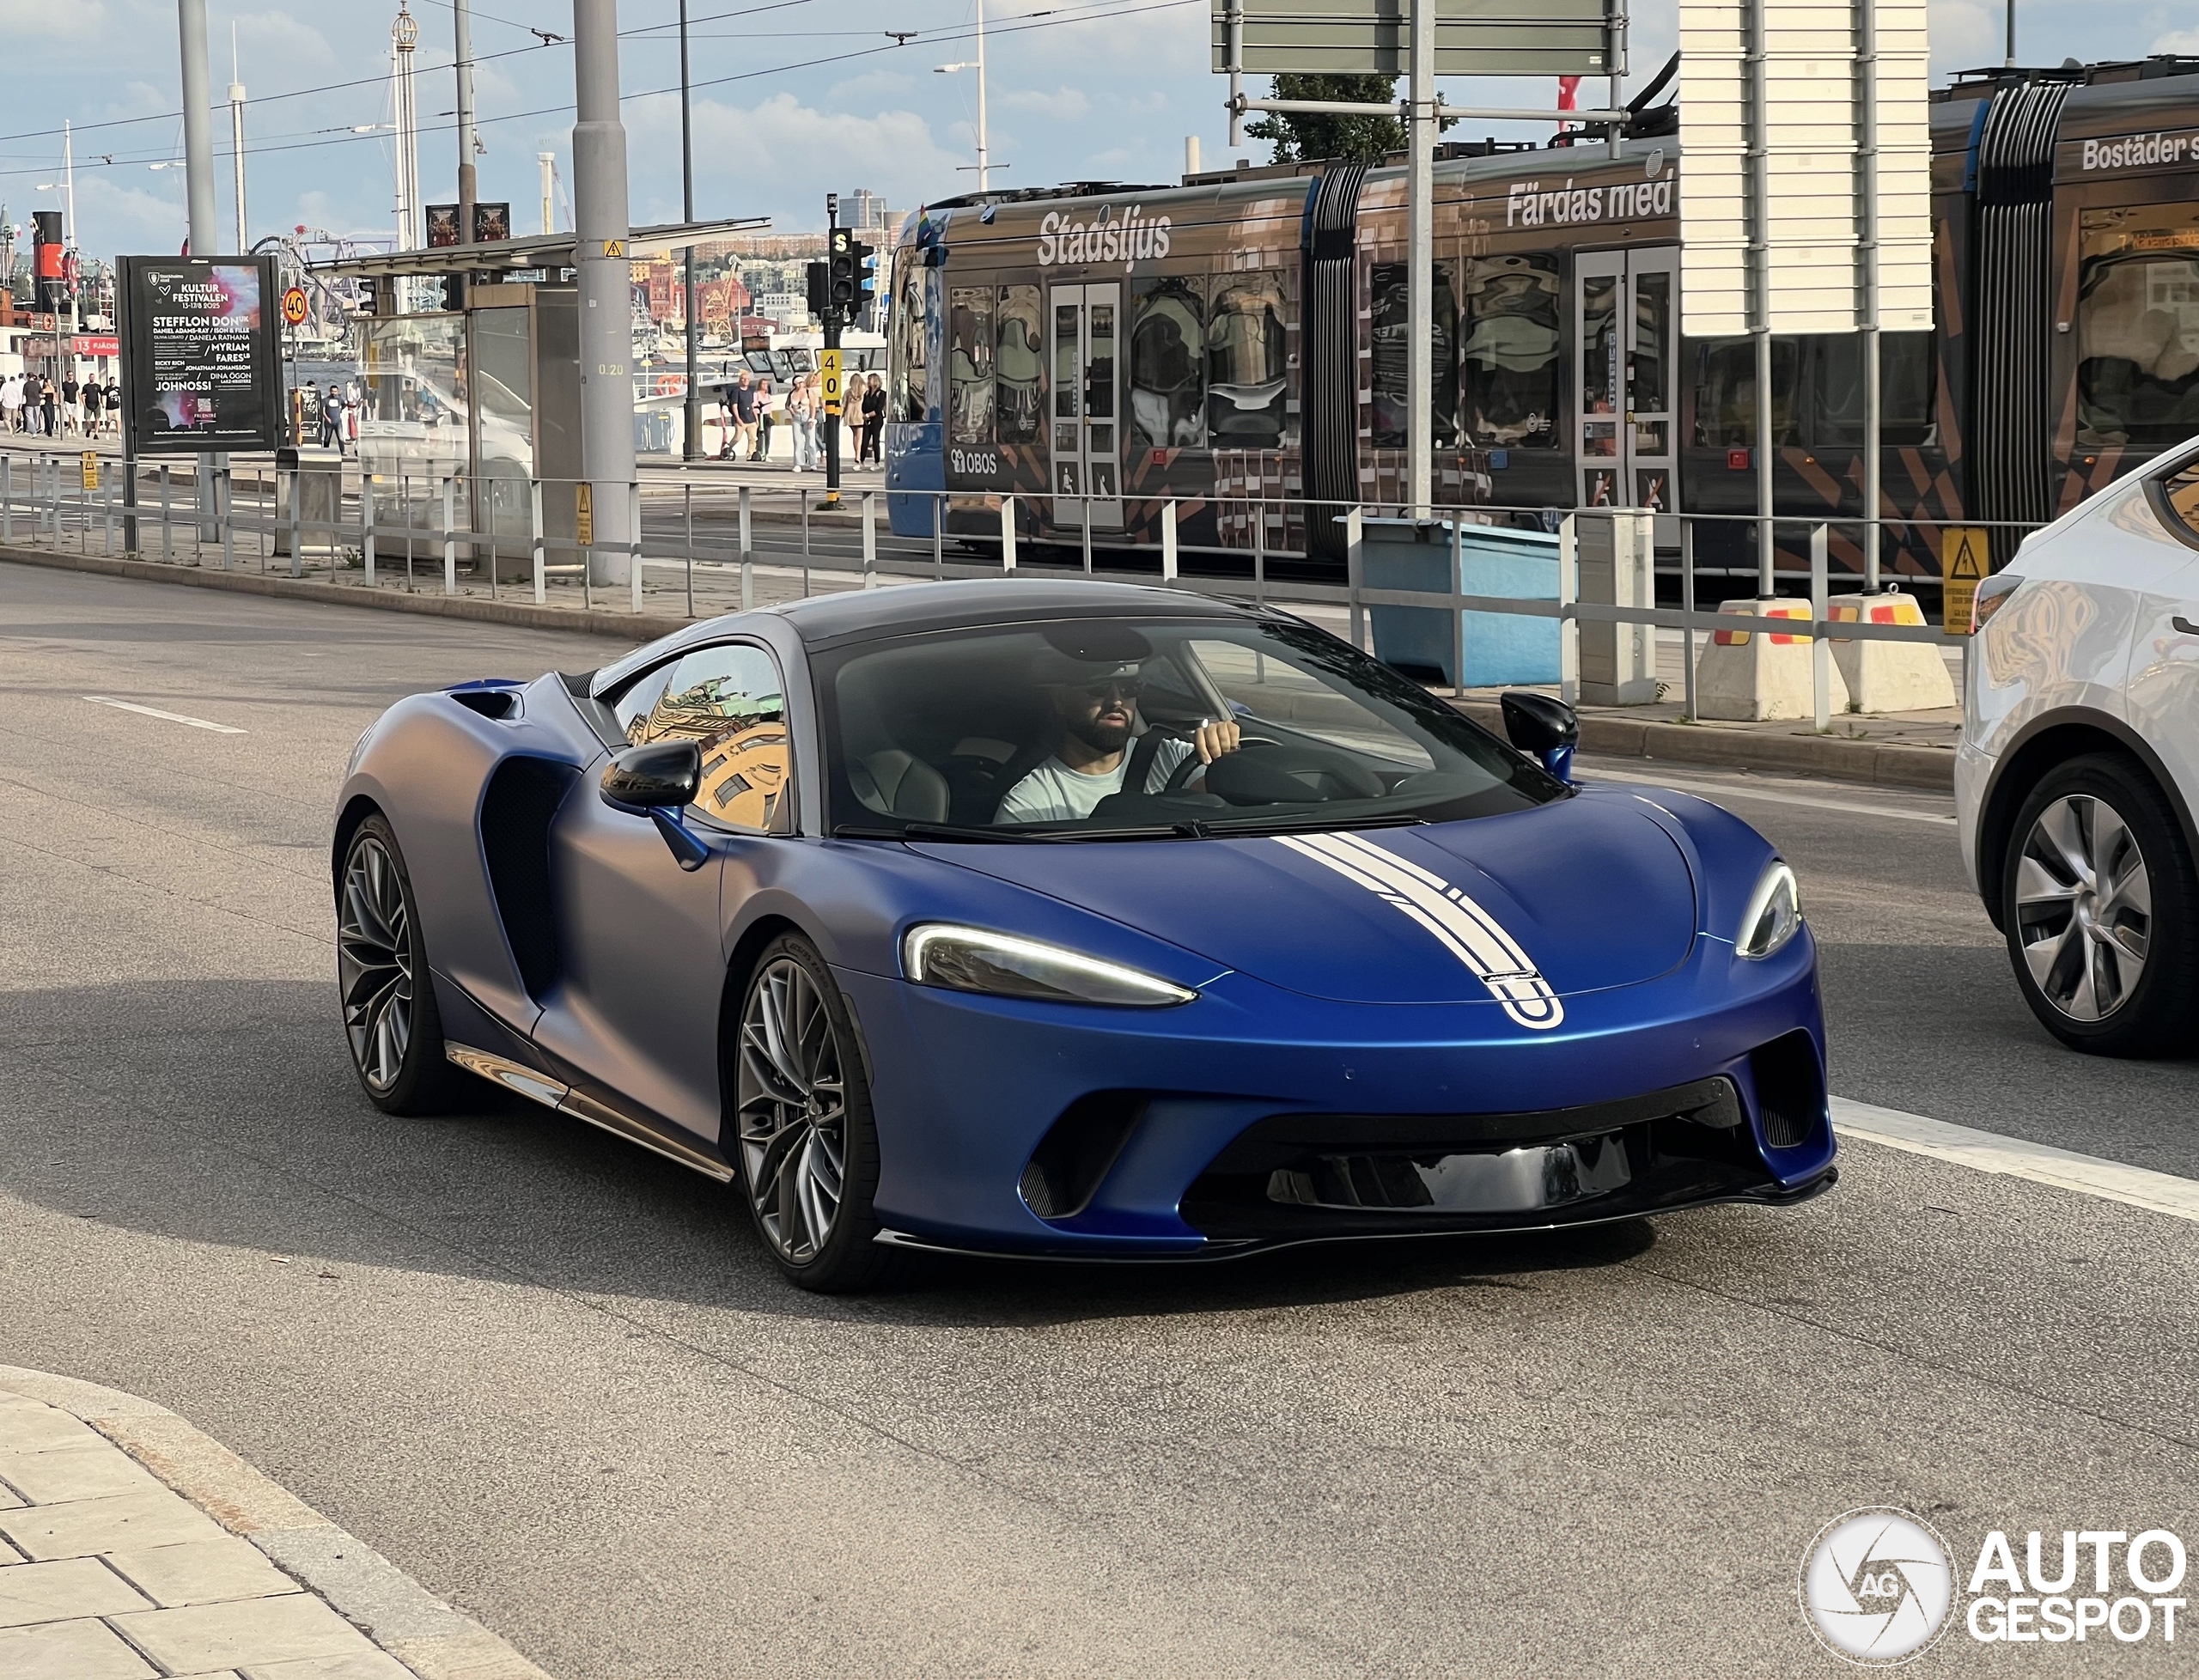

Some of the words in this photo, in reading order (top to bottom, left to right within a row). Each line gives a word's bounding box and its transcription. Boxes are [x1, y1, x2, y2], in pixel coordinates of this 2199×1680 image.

[2083, 132, 2187, 170] Bostäder
[1507, 178, 1603, 228] Färdas
[1609, 167, 1674, 218] med
[1037, 204, 1172, 273] Stadsljus
[181, 283, 219, 293] KULTUR
[172, 293, 228, 302] FESTIVALEN
[287, 296, 304, 315] 40
[153, 316, 210, 327] STEFFLON
[77, 341, 90, 351] 13
[211, 343, 250, 351] MYRIAM
[216, 353, 244, 362] FARES
[228, 371, 252, 380] ÖGON
[155, 380, 212, 392] JOHNOSSI
[966, 452, 997, 475] OBOS
